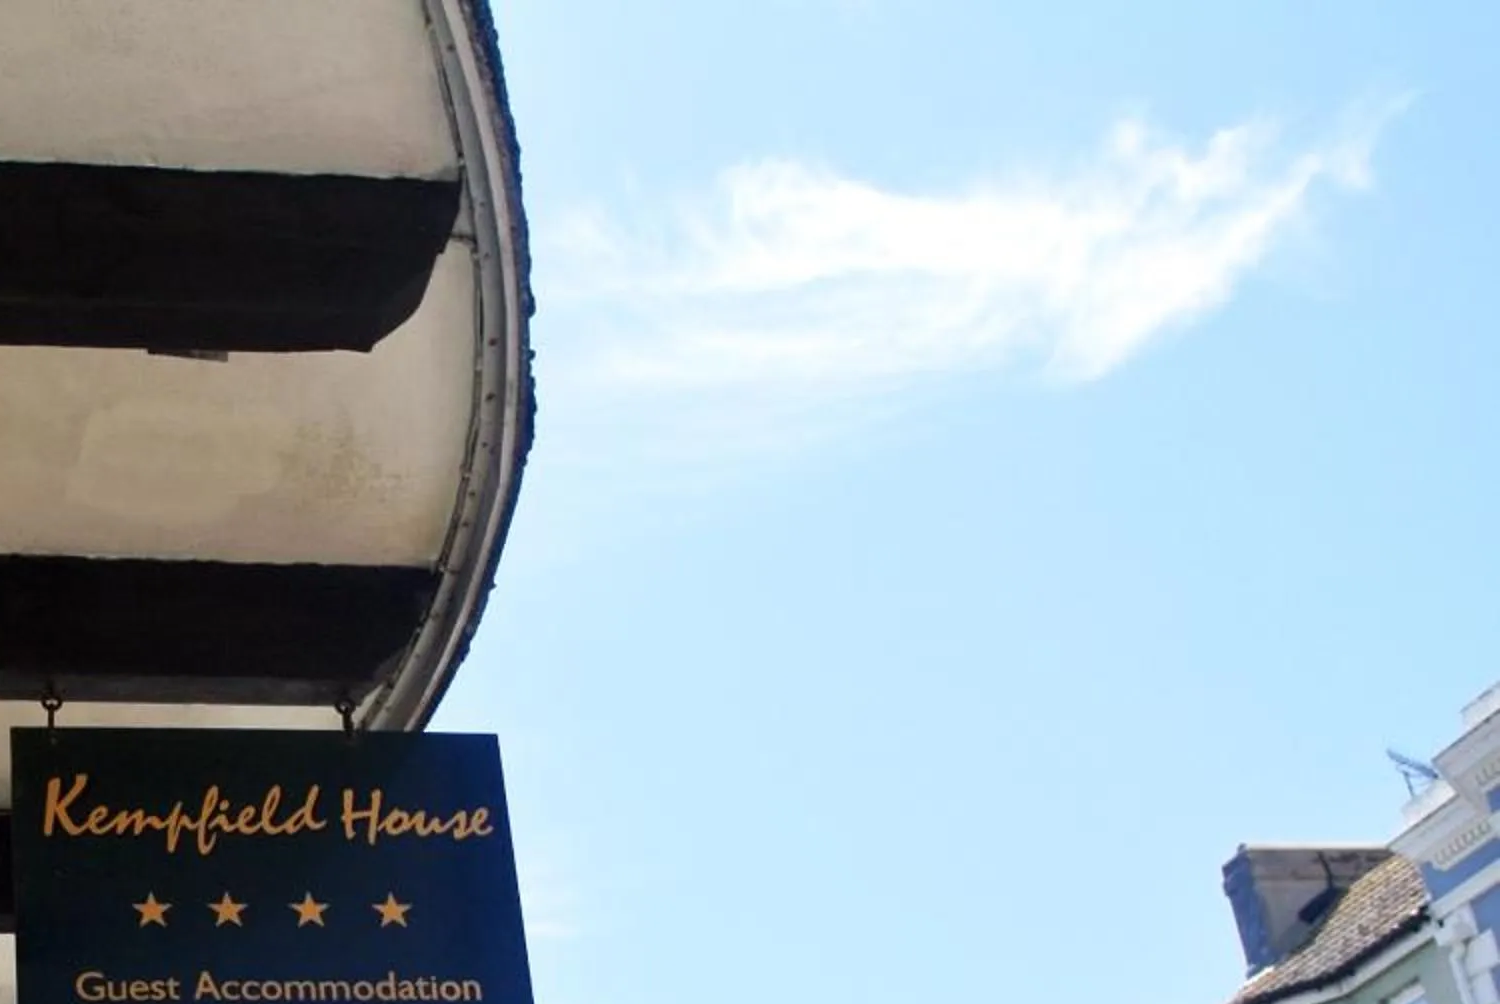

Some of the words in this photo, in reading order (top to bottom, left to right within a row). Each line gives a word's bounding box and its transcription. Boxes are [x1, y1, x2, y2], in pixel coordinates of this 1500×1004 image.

[44, 775, 326, 854] Kempfield
[341, 789, 493, 844] House
[76, 972, 179, 1000] Guest
[196, 972, 481, 1001] Accommodation
